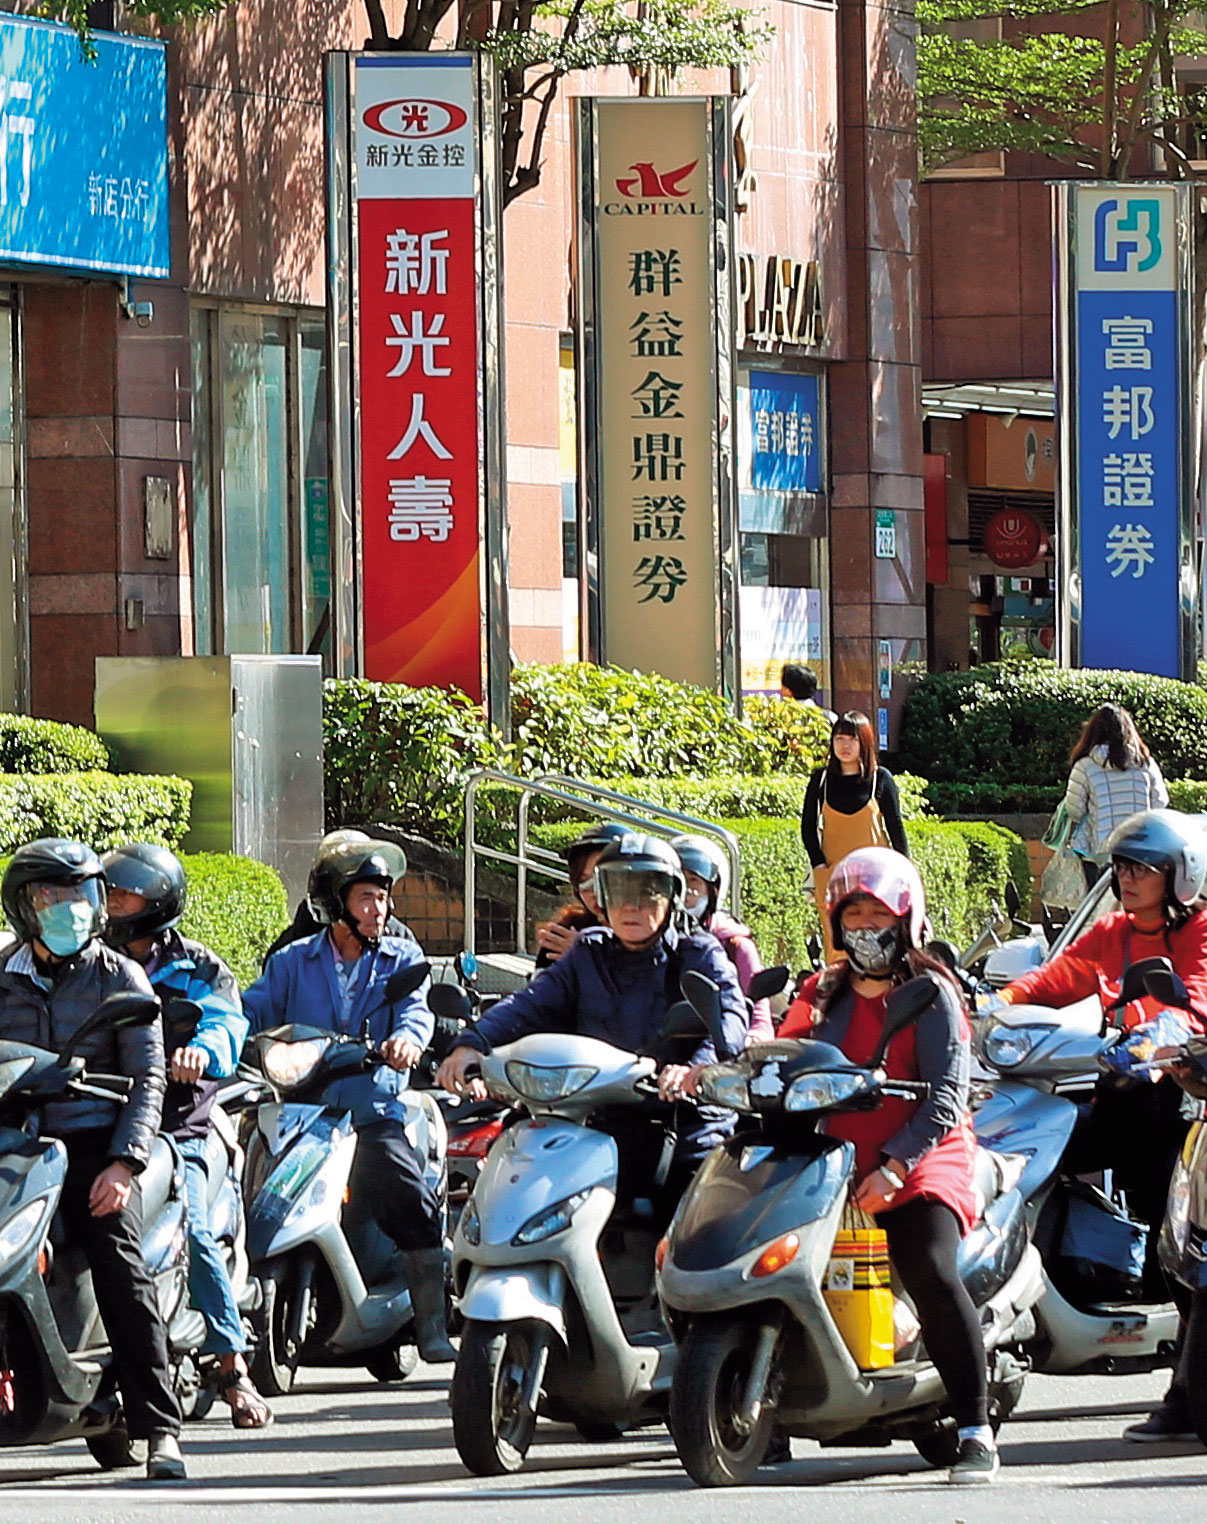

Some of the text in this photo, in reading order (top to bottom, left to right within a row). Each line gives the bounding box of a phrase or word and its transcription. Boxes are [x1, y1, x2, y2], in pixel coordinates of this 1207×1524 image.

[400, 104, 429, 132] 光
[366, 144, 466, 168] 新光金控
[89, 170, 150, 223] 新店分行
[603, 202, 704, 217] CAPITAL
[735, 252, 824, 348] PLAZA
[384, 228, 455, 542] 新光人壽
[627, 248, 688, 604] 群益金鼎證券
[755, 407, 814, 457] 富邦證券
[1102, 315, 1155, 579] 富邦證券
[879, 530, 894, 555] 262
